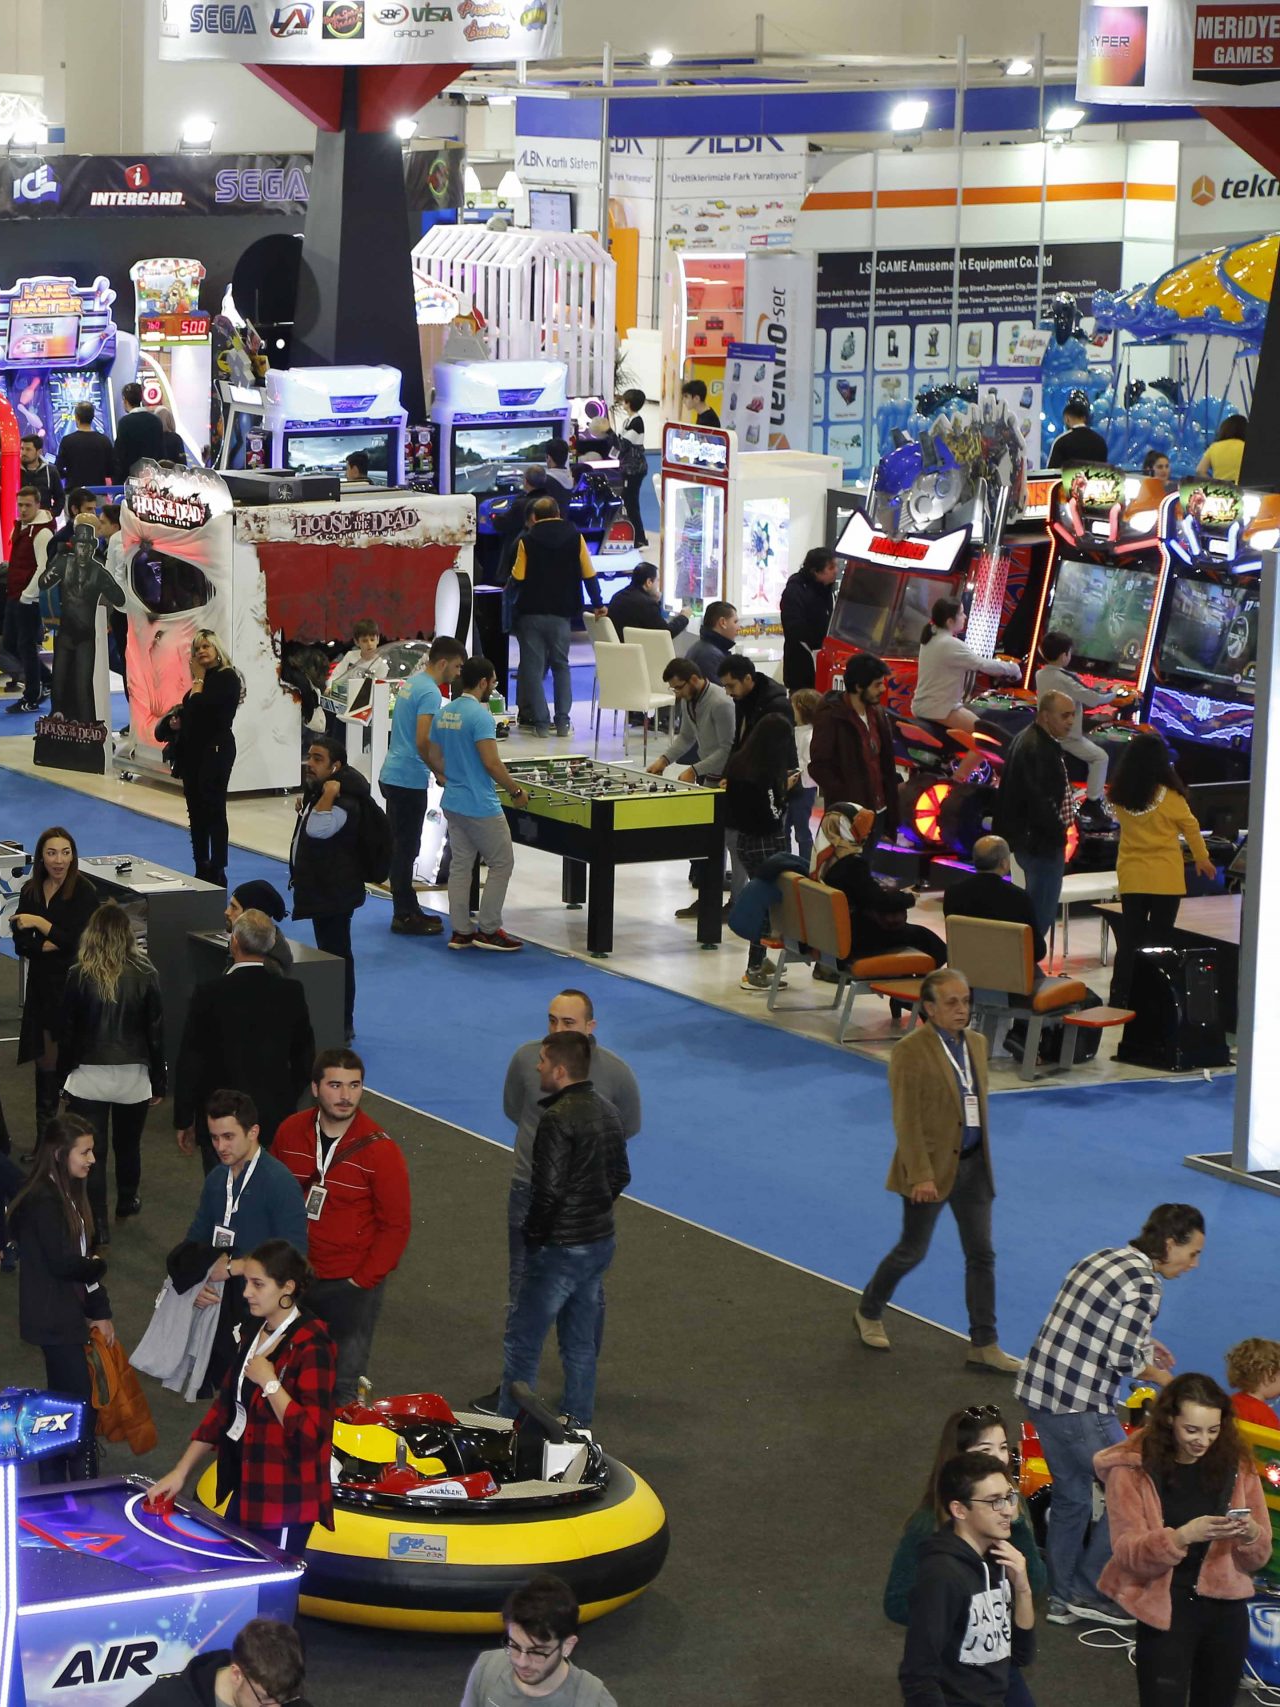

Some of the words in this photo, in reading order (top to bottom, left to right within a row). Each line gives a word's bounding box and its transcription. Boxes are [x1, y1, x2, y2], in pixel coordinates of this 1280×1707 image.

[190, 5, 257, 34] SEGA
[412, 3, 453, 23] VISA
[393, 29, 434, 38] GROUP
[1214, 46, 1274, 65] GAMES
[570, 157, 598, 170] Sistem
[13, 164, 57, 200] ICE
[215, 169, 309, 203] SEGA
[968, 258, 1018, 272] Equipment
[23, 283, 70, 299] LANE
[11, 298, 82, 314] MASTER
[181, 320, 207, 334] 500
[136, 498, 166, 516] HOUSE
[176, 502, 200, 522] DEAD
[296, 513, 352, 536] HOUSE
[372, 509, 417, 531] DEAD
[40, 722, 68, 736] HOUSE
[78, 728, 101, 740] DEAD
[31, 1413, 73, 1434] FX
[52, 1641, 158, 1688] AIR
